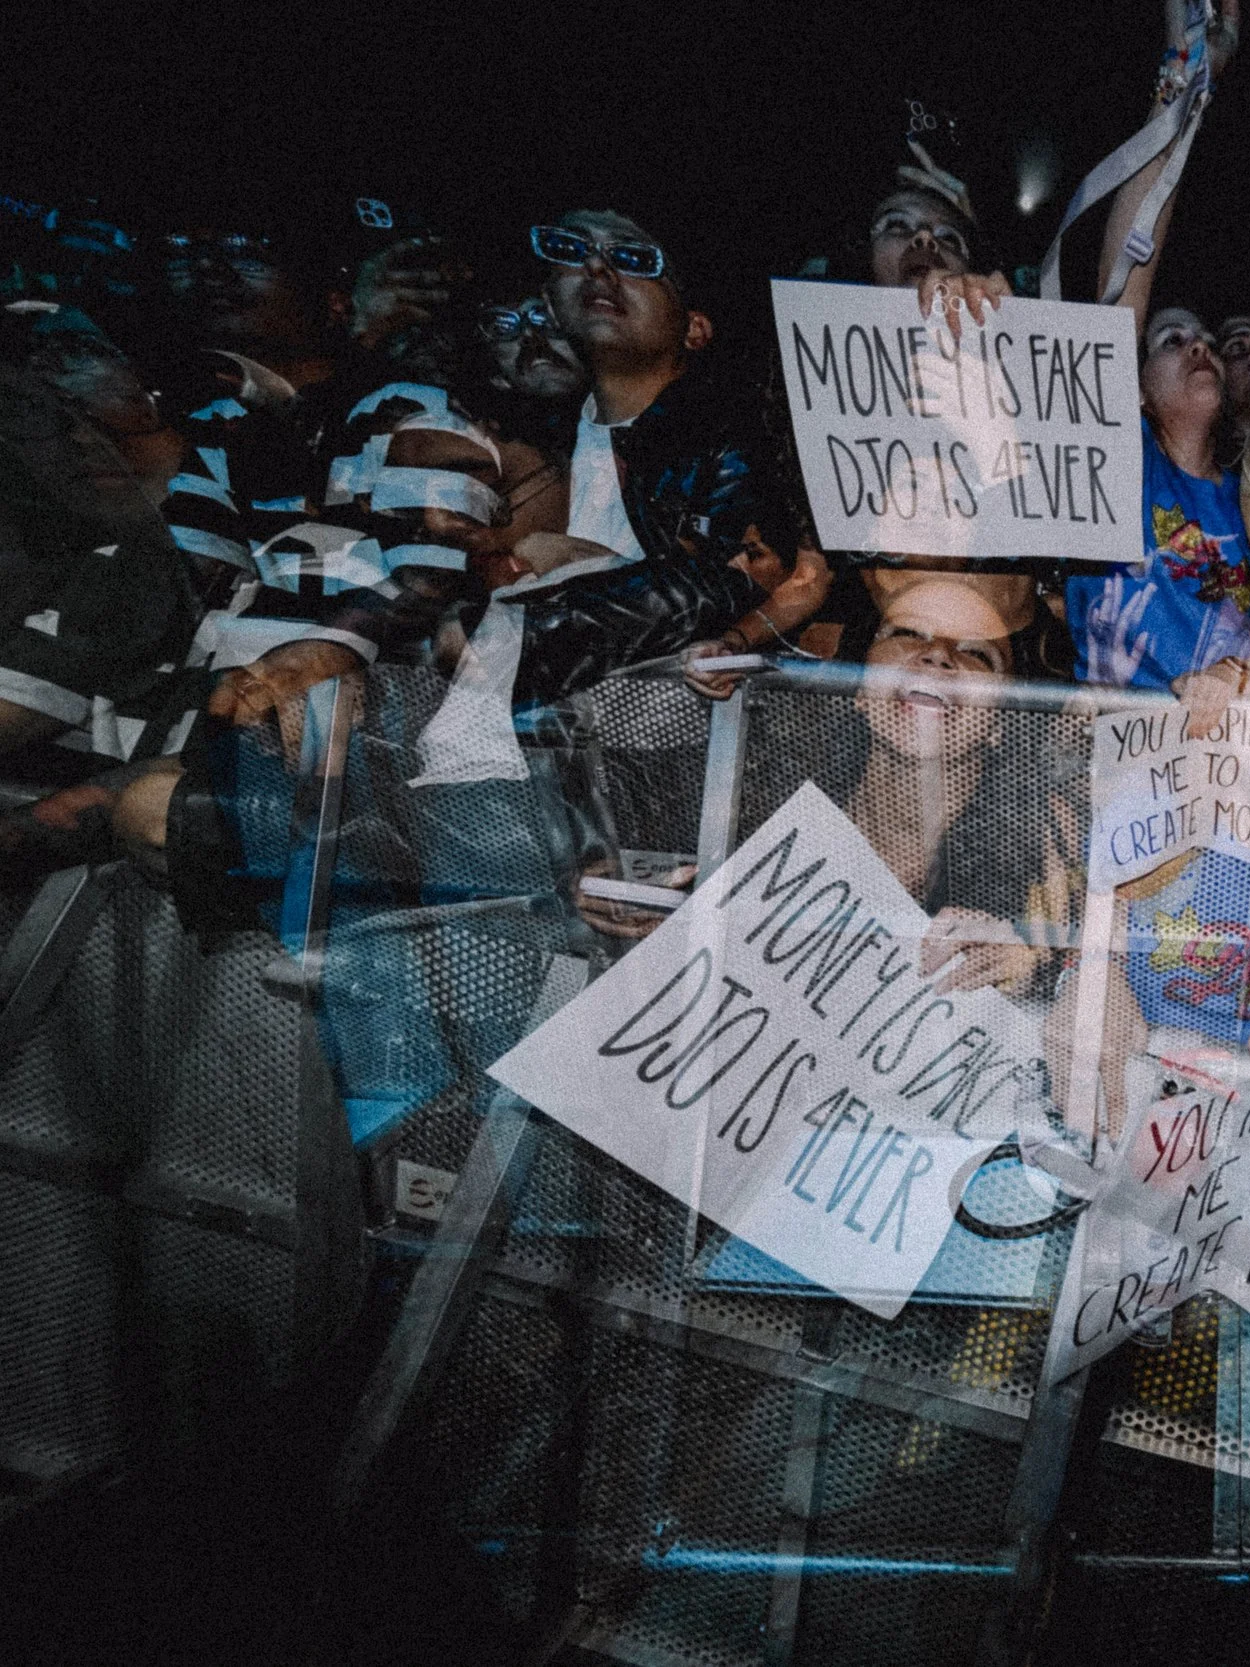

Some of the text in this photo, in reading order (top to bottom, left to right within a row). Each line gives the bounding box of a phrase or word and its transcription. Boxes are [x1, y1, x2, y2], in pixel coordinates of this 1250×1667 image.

[792, 321, 1121, 426] MONEY IS FAKE
[827, 435, 1117, 524] DJO IS 4EVER
[1111, 712, 1169, 762] YOU
[1150, 752, 1240, 800] ME TO
[1110, 796, 1202, 866] CREATE
[715, 827, 910, 1039] MONEY
[857, 983, 954, 1076] IS
[598, 946, 935, 1253] DJO IS 4EVER
[1143, 1090, 1236, 1183] YOU
[1173, 1155, 1241, 1235] ME
[1073, 1216, 1243, 1347] CREATE
